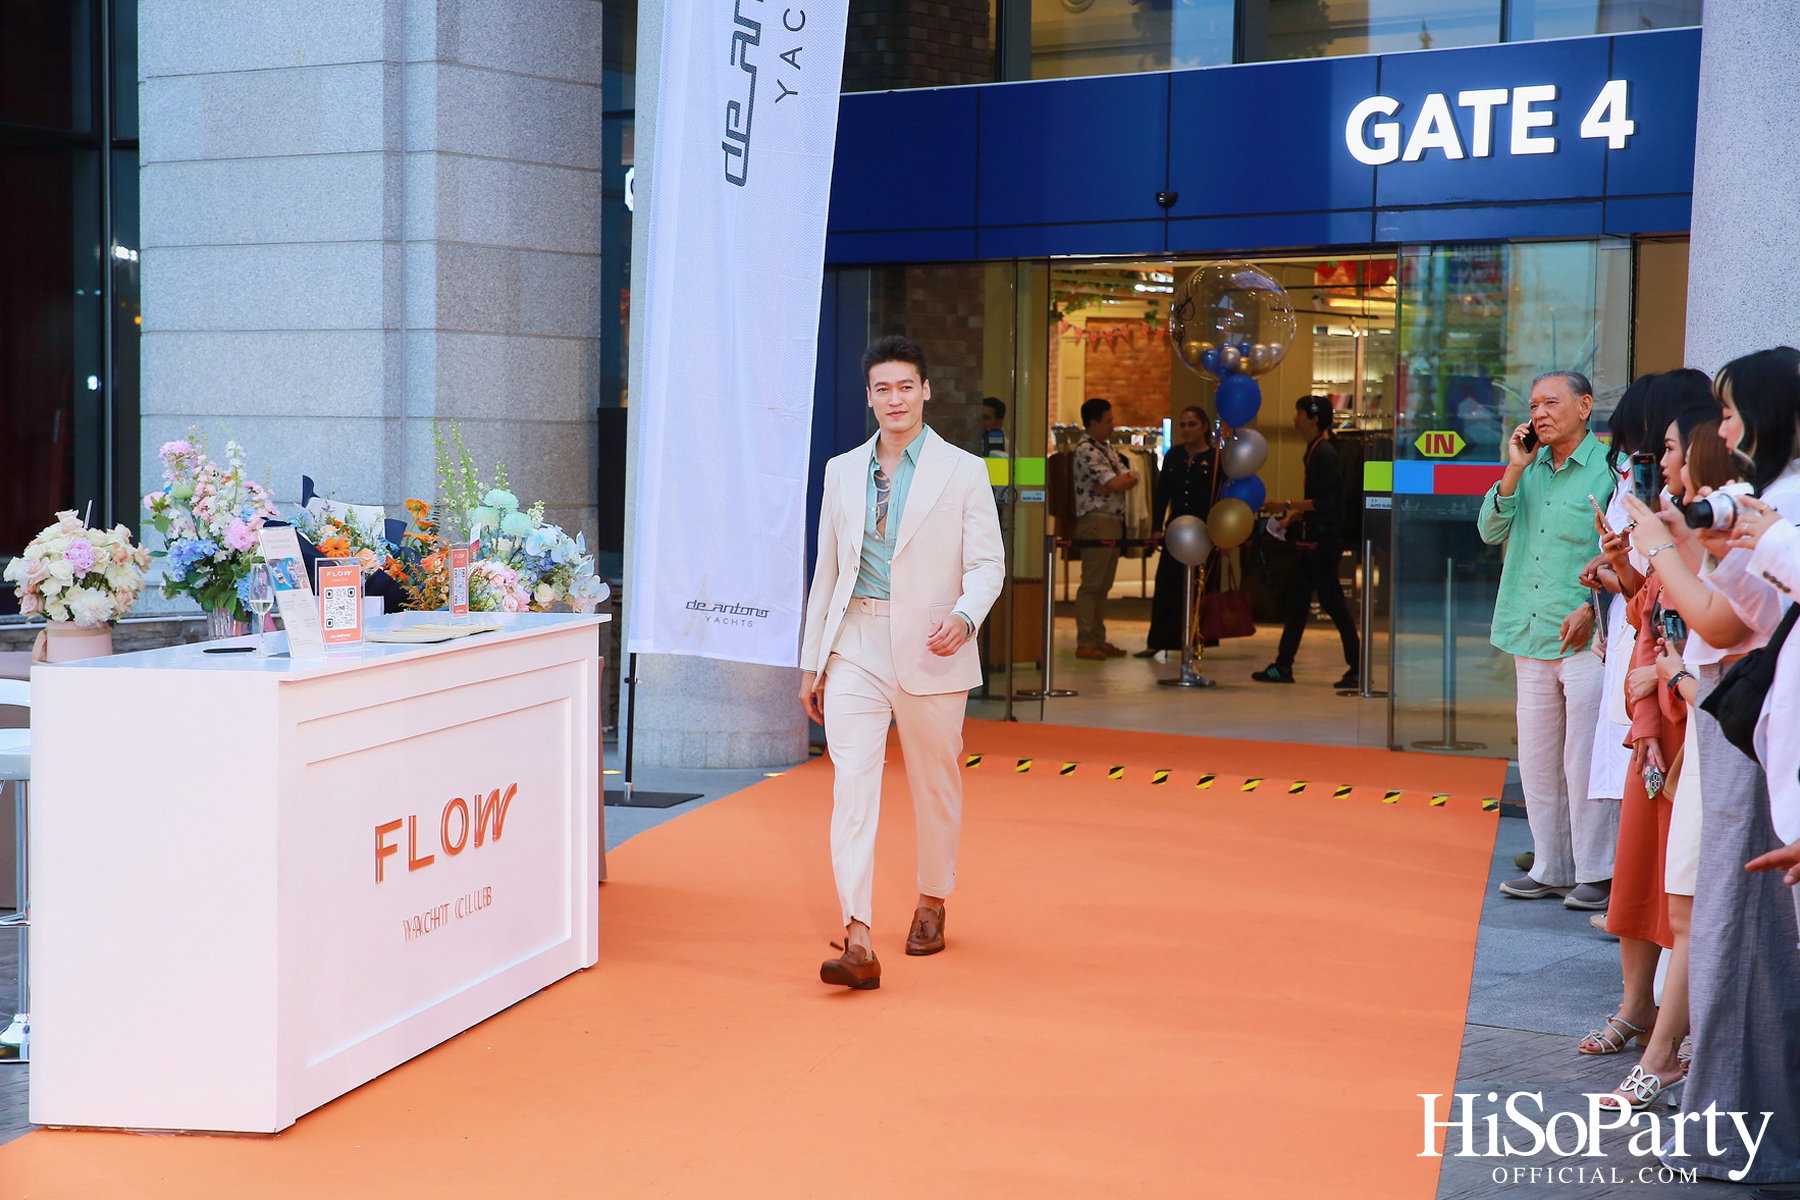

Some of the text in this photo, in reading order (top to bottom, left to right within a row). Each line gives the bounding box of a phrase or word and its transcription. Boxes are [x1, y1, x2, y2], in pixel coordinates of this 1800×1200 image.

[1345, 79, 1635, 166] GATE 4
[1425, 433, 1455, 455] IN
[326, 570, 353, 578] FLOW
[704, 615, 754, 628] YACHTS
[375, 782, 518, 885] FLOW
[402, 885, 493, 943] YACHT CLUB
